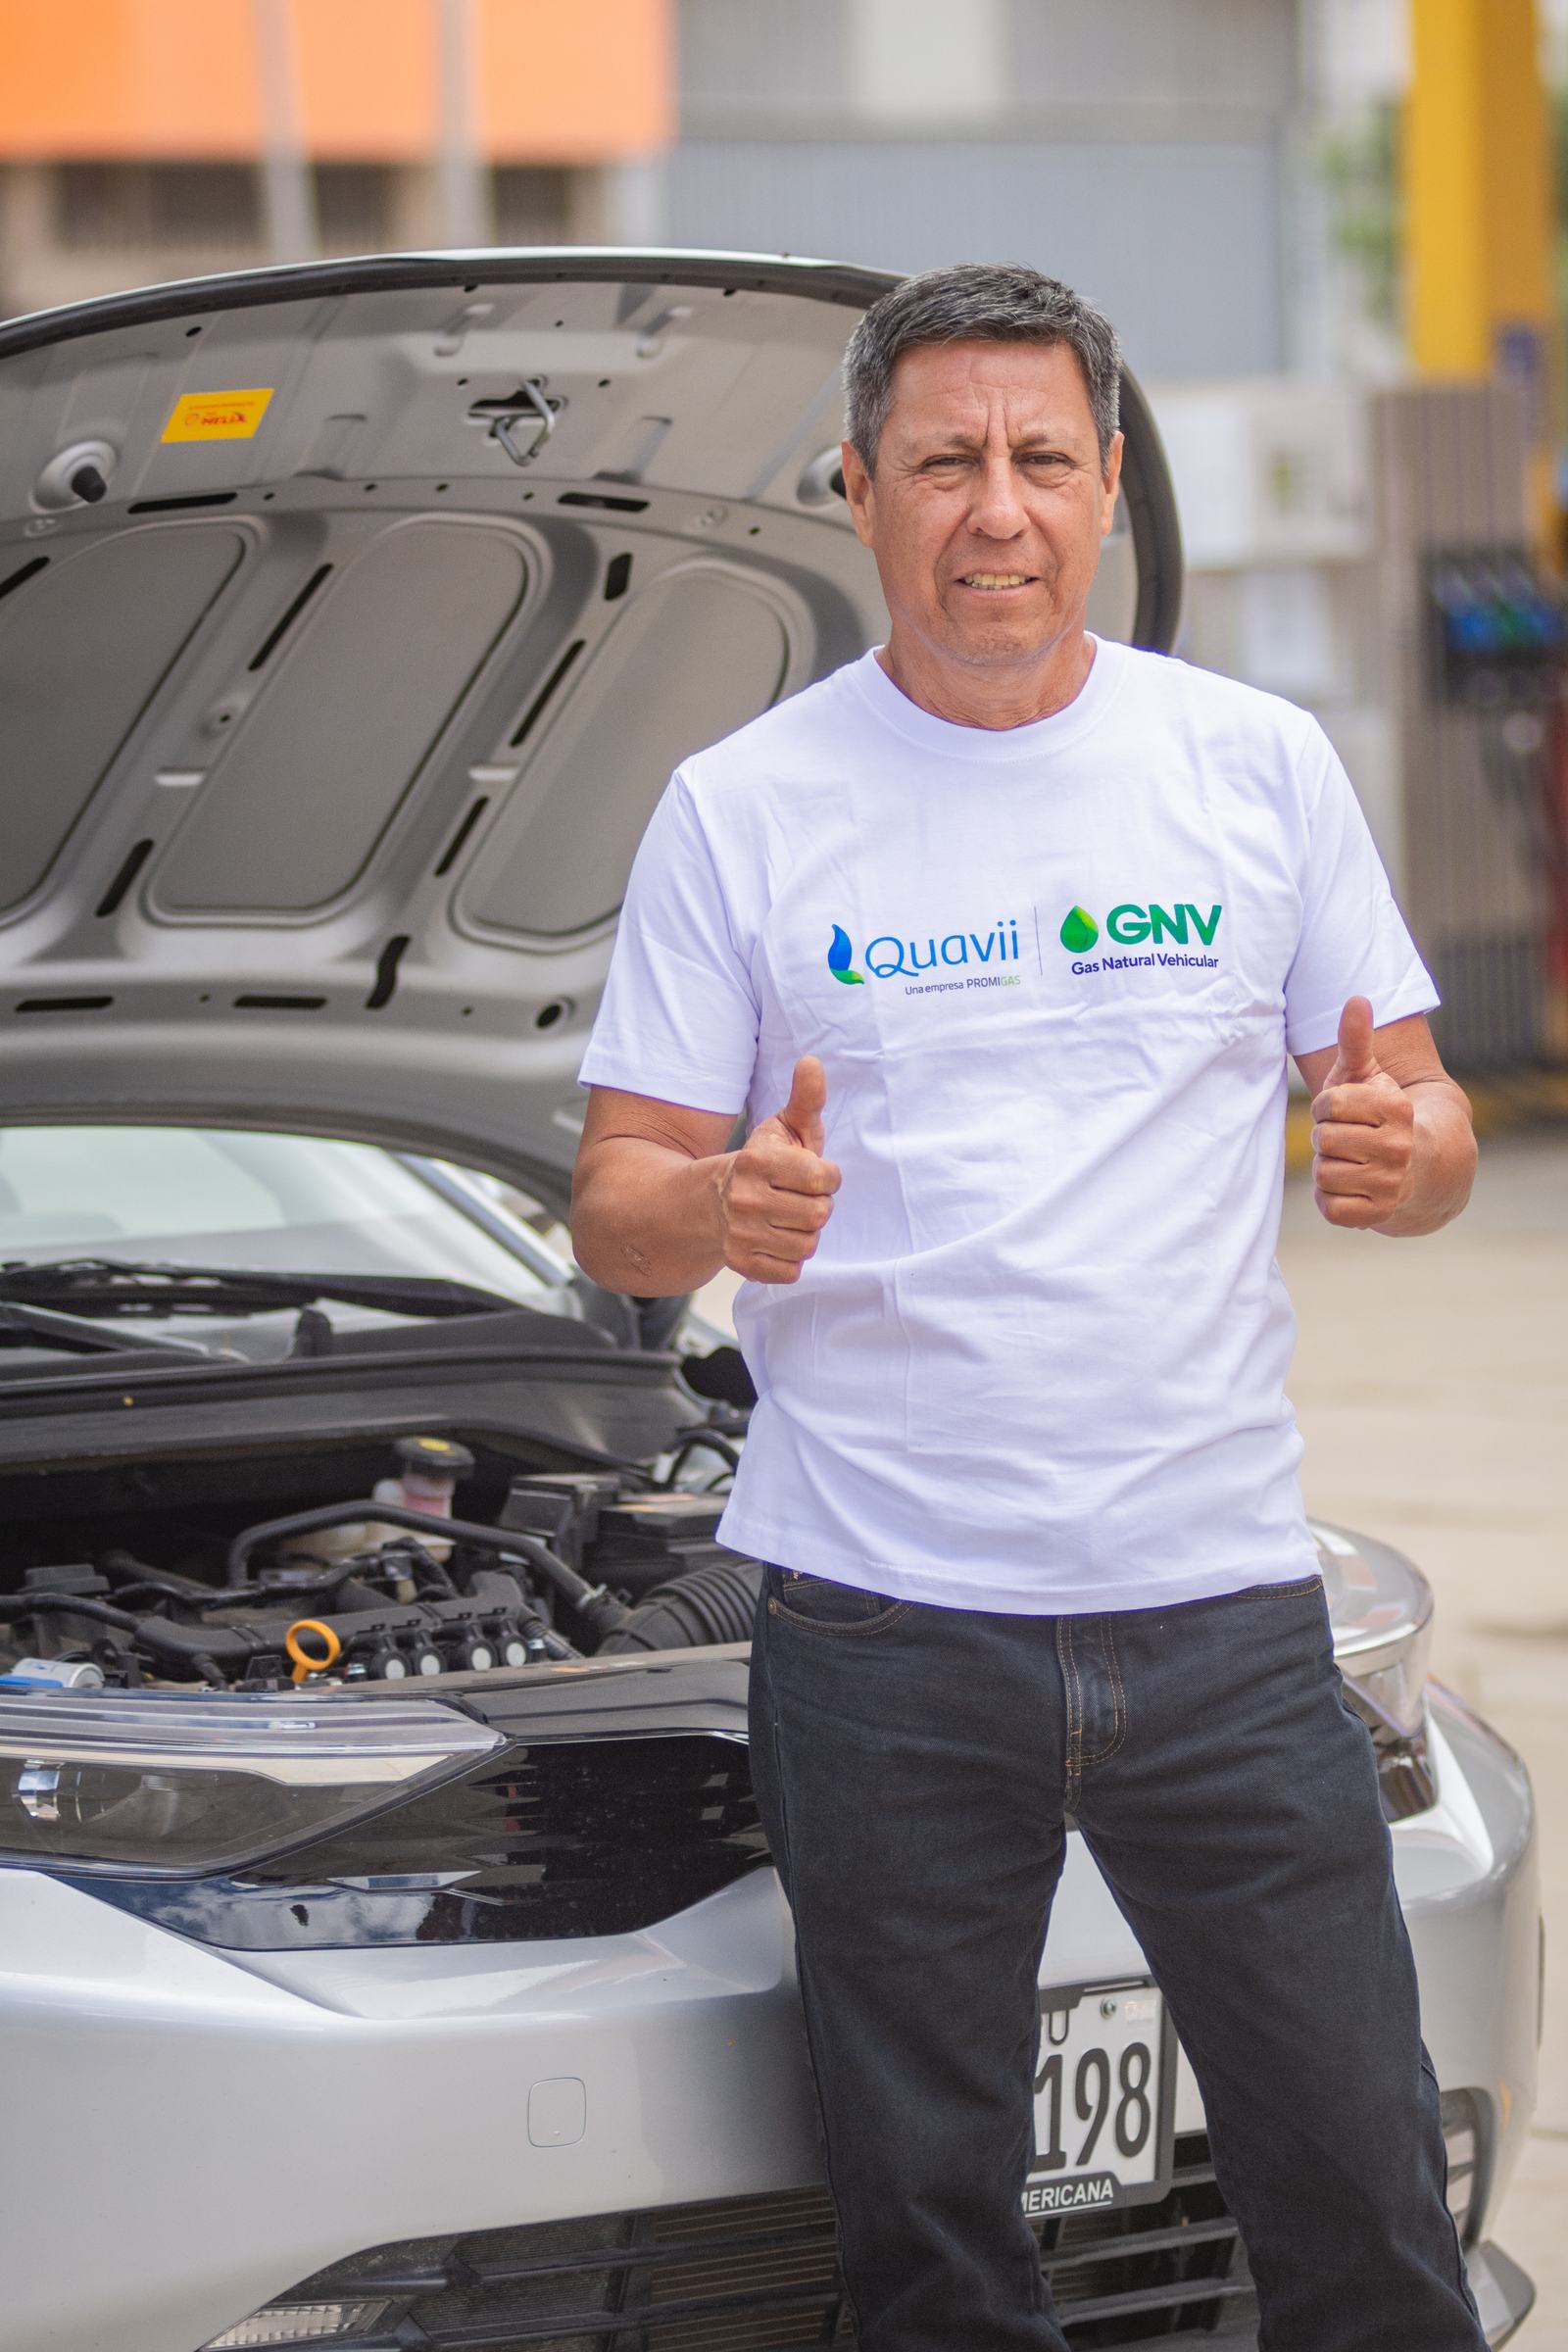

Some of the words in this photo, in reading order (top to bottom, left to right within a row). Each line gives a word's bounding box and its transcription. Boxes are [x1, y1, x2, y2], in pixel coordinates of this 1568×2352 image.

[1106, 904, 1223, 946] GNV
[865, 919, 1019, 978] Quavii
[1071, 961, 1100, 975] Gas
[1102, 954, 1155, 971] Natural
[1156, 953, 1220, 968] Vehicular
[905, 986, 924, 996] Una
[924, 981, 964, 994] empresa
[966, 975, 1021, 989] PROMIGAS
[1032, 2041, 1152, 2173] 198
